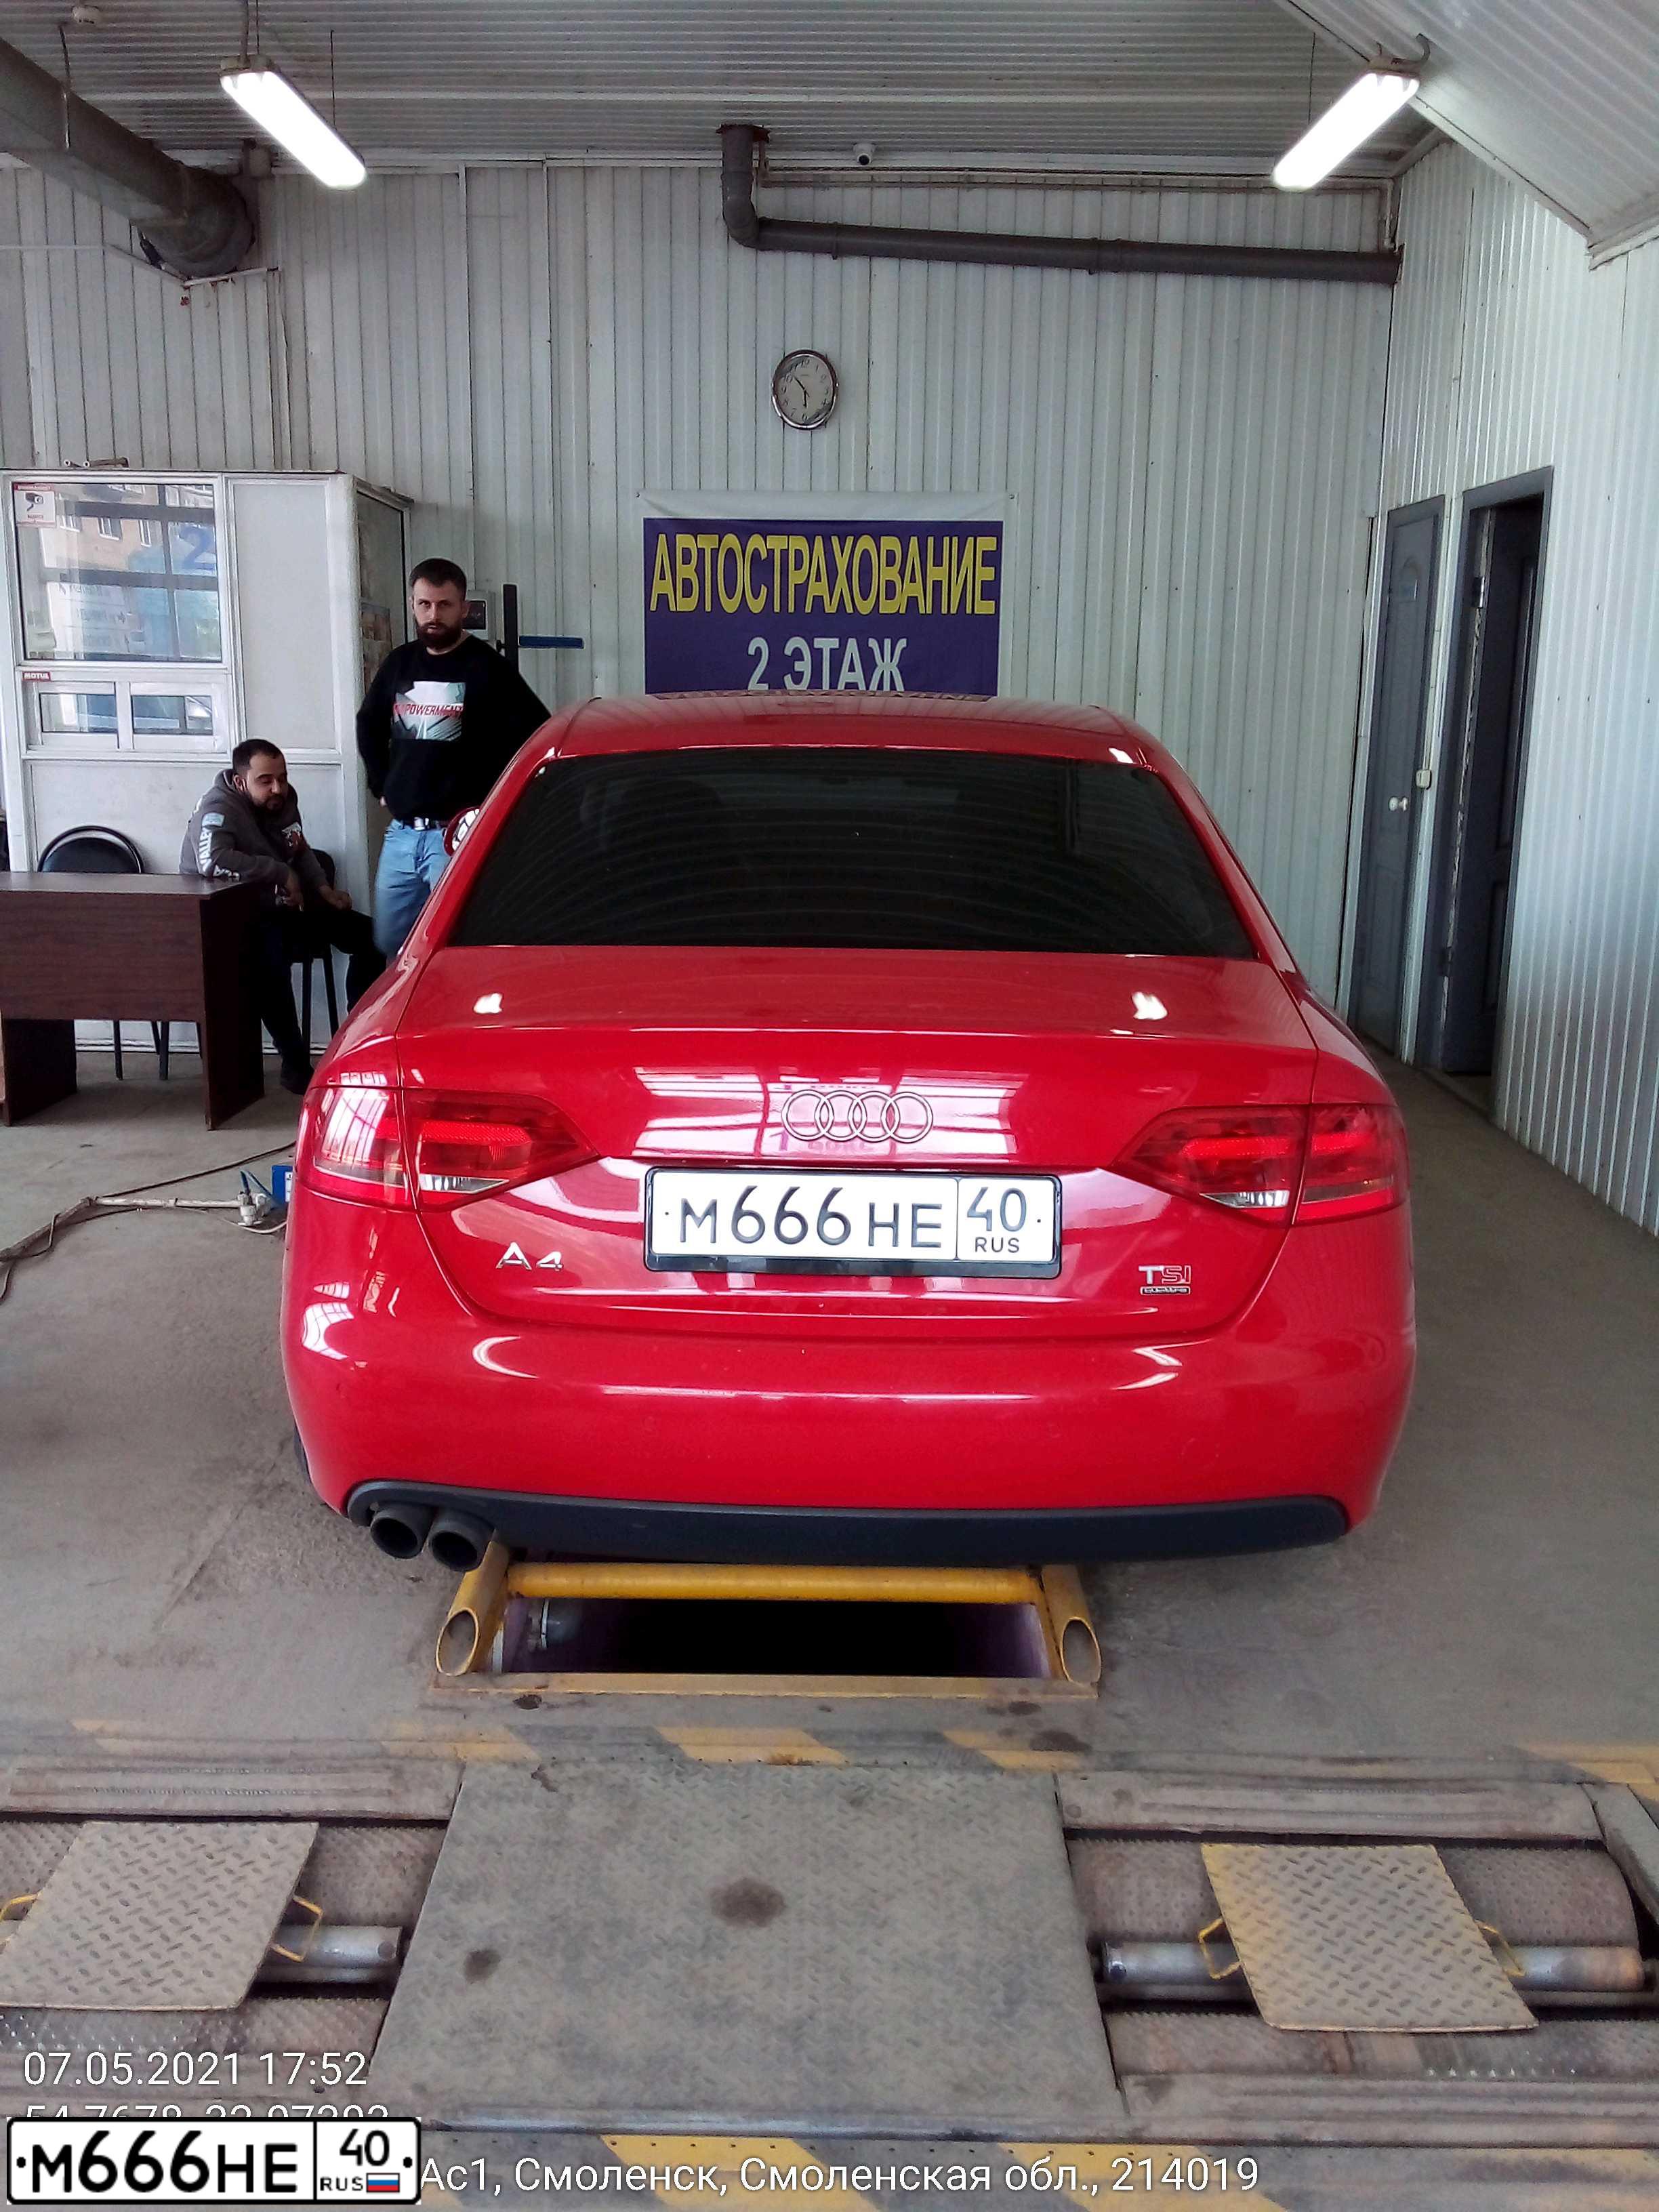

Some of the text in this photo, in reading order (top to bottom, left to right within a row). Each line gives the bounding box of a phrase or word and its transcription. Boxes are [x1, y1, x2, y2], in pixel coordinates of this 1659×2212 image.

[650, 533, 998, 615] АВТОСТРАХОВАНИЕ
[747, 636, 908, 692] 2 ЭТАЖ
[966, 1187, 1027, 1232] 40
[495, 1242, 564, 1271] A4
[975, 1237, 1021, 1254] RUS
[1139, 1265, 1191, 1284] TSI
